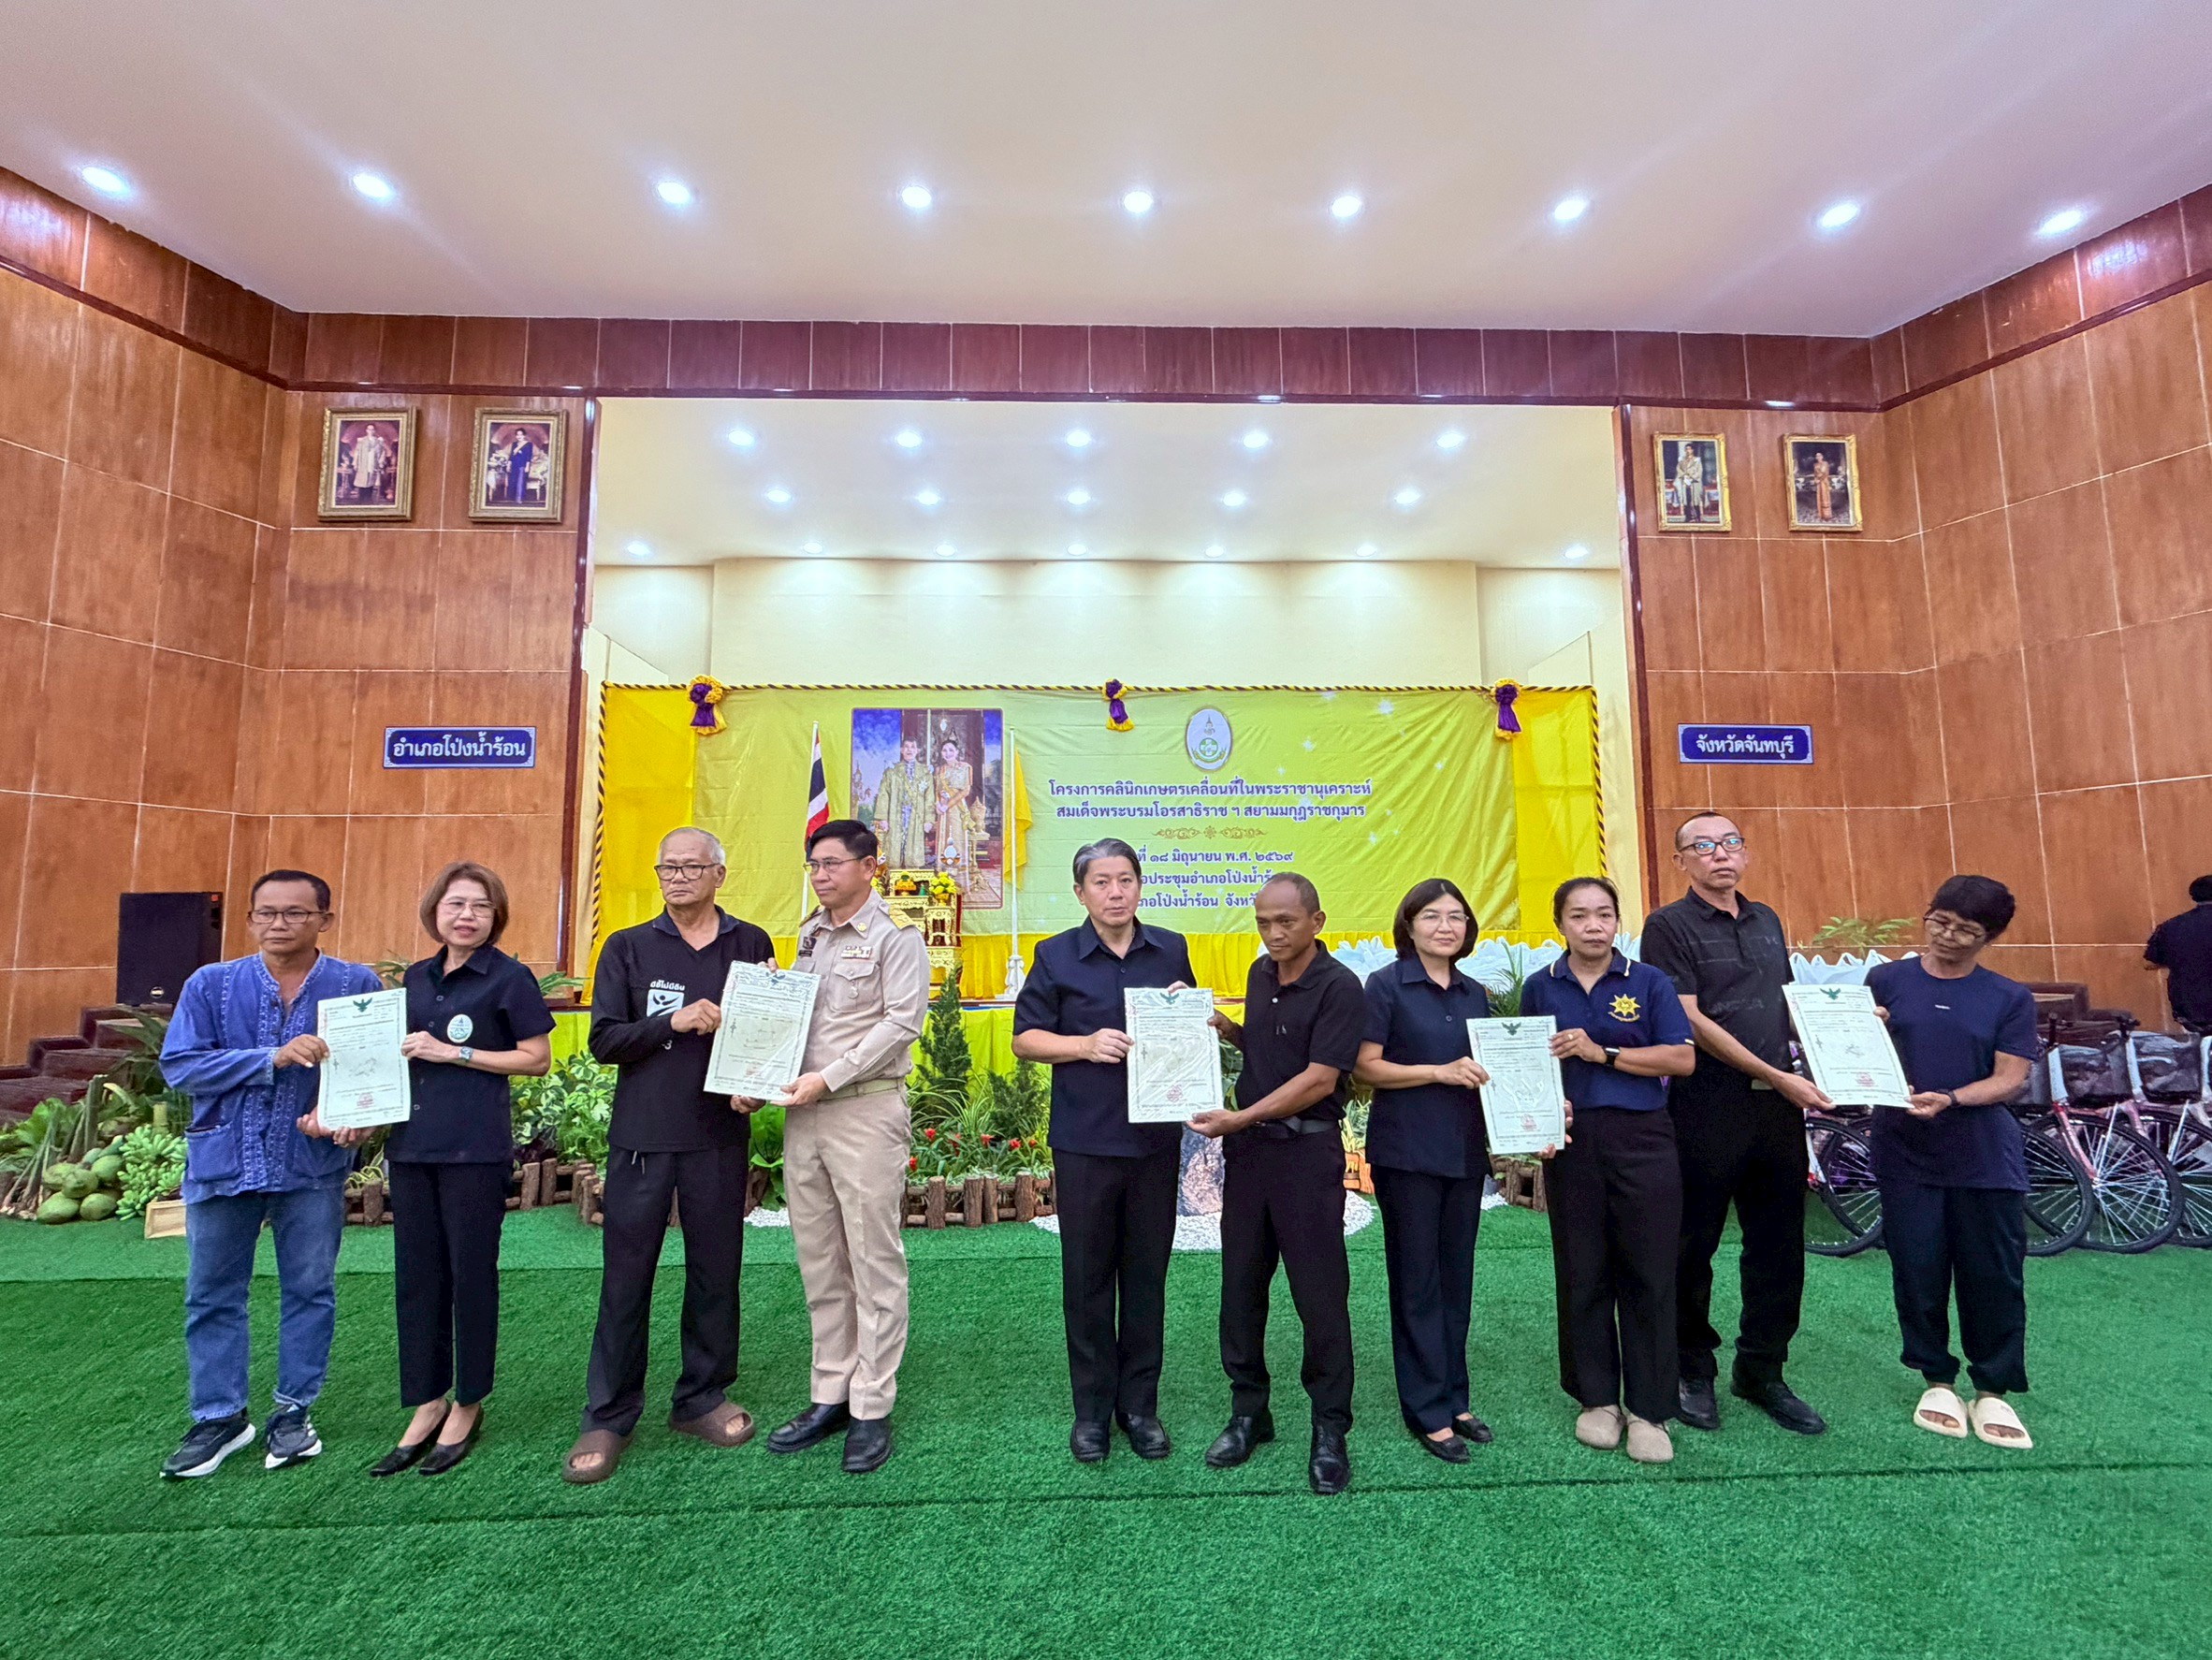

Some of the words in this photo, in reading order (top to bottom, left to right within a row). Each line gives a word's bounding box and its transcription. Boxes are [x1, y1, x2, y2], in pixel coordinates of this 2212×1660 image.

[393, 731, 526, 757] อำเภอโป่งน้ำร้อน
[1695, 734, 1795, 759] จังหวัดจันทบุรี
[1048, 776, 1372, 799] โครงการคลินิกเกษตรเคลื่อนที่ในพระราชานุเคราะห์
[1055, 801, 1228, 818] สมเด็จพระบรมโอรสาธิราช
[1149, 852, 1170, 863] ๑๘
[1171, 848, 1223, 866] มิถุนายน
[1225, 851, 1252, 862] พ.ศ.
[1255, 851, 1294, 862] ๒๕๖๙
[1138, 888, 1219, 908] ภอโป่งน้ำร้อน
